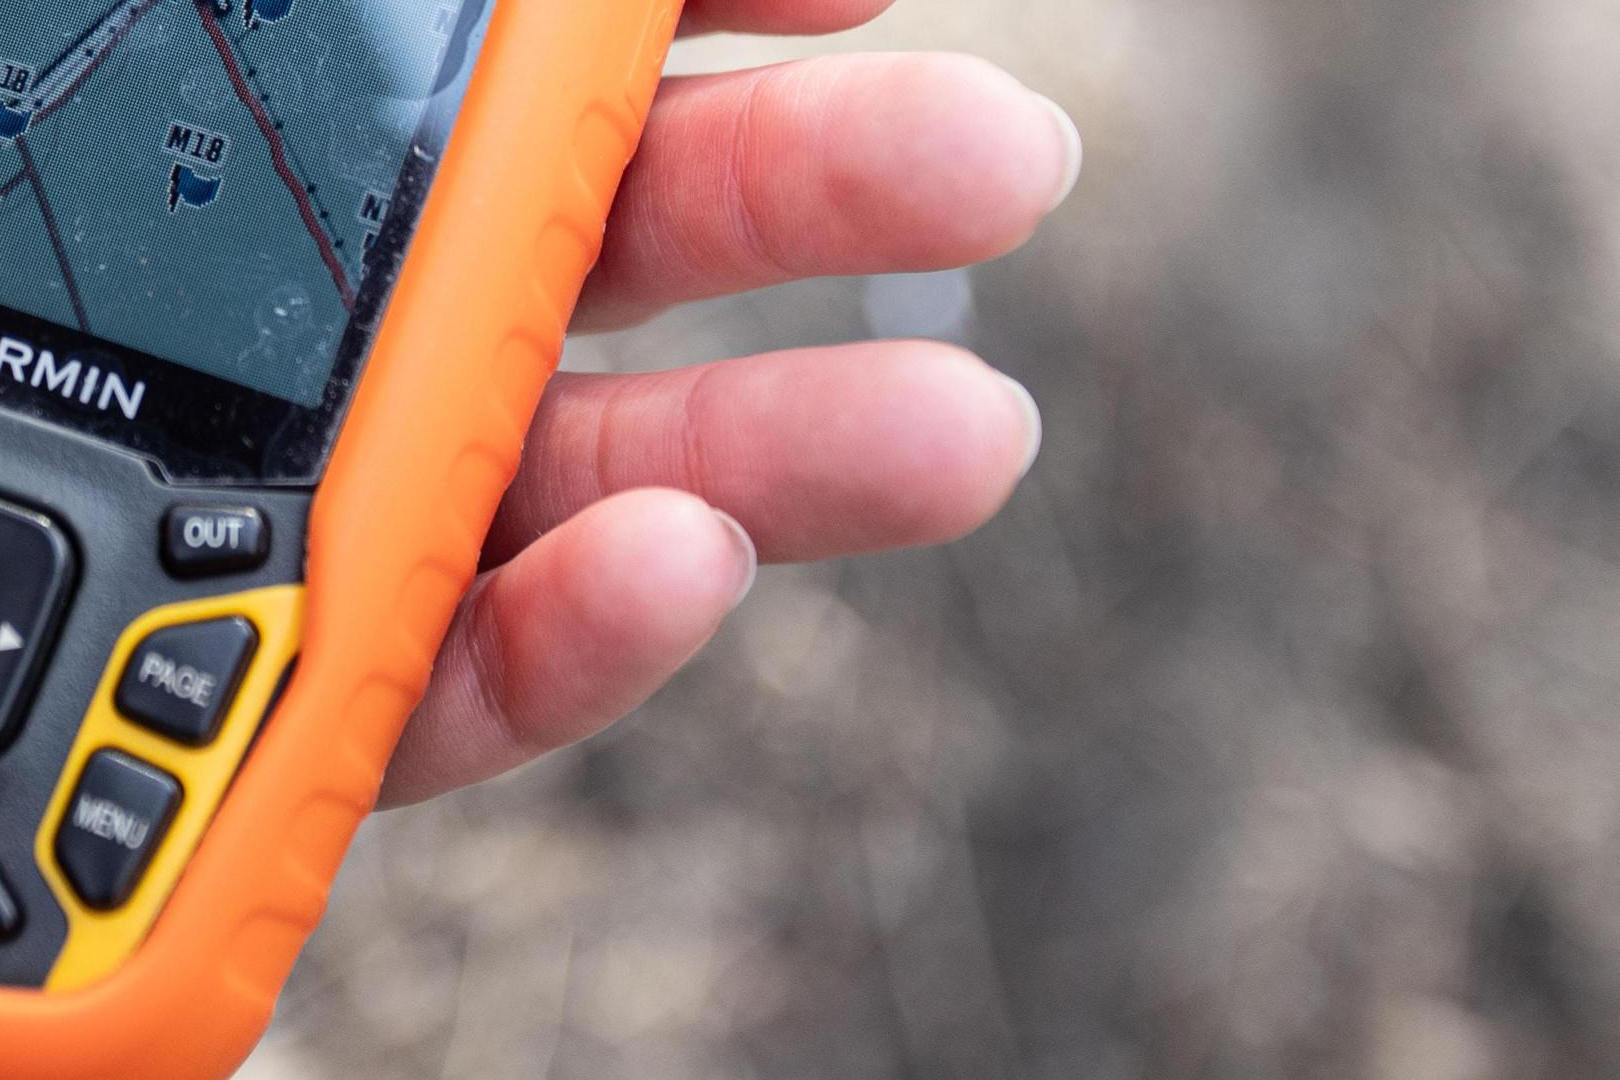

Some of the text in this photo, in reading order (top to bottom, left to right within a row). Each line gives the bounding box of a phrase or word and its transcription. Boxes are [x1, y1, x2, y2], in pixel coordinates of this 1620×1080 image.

[167, 123, 225, 164] M18
[184, 518, 244, 549] OUT
[140, 653, 215, 706] PAGE
[74, 795, 150, 849] MENU
